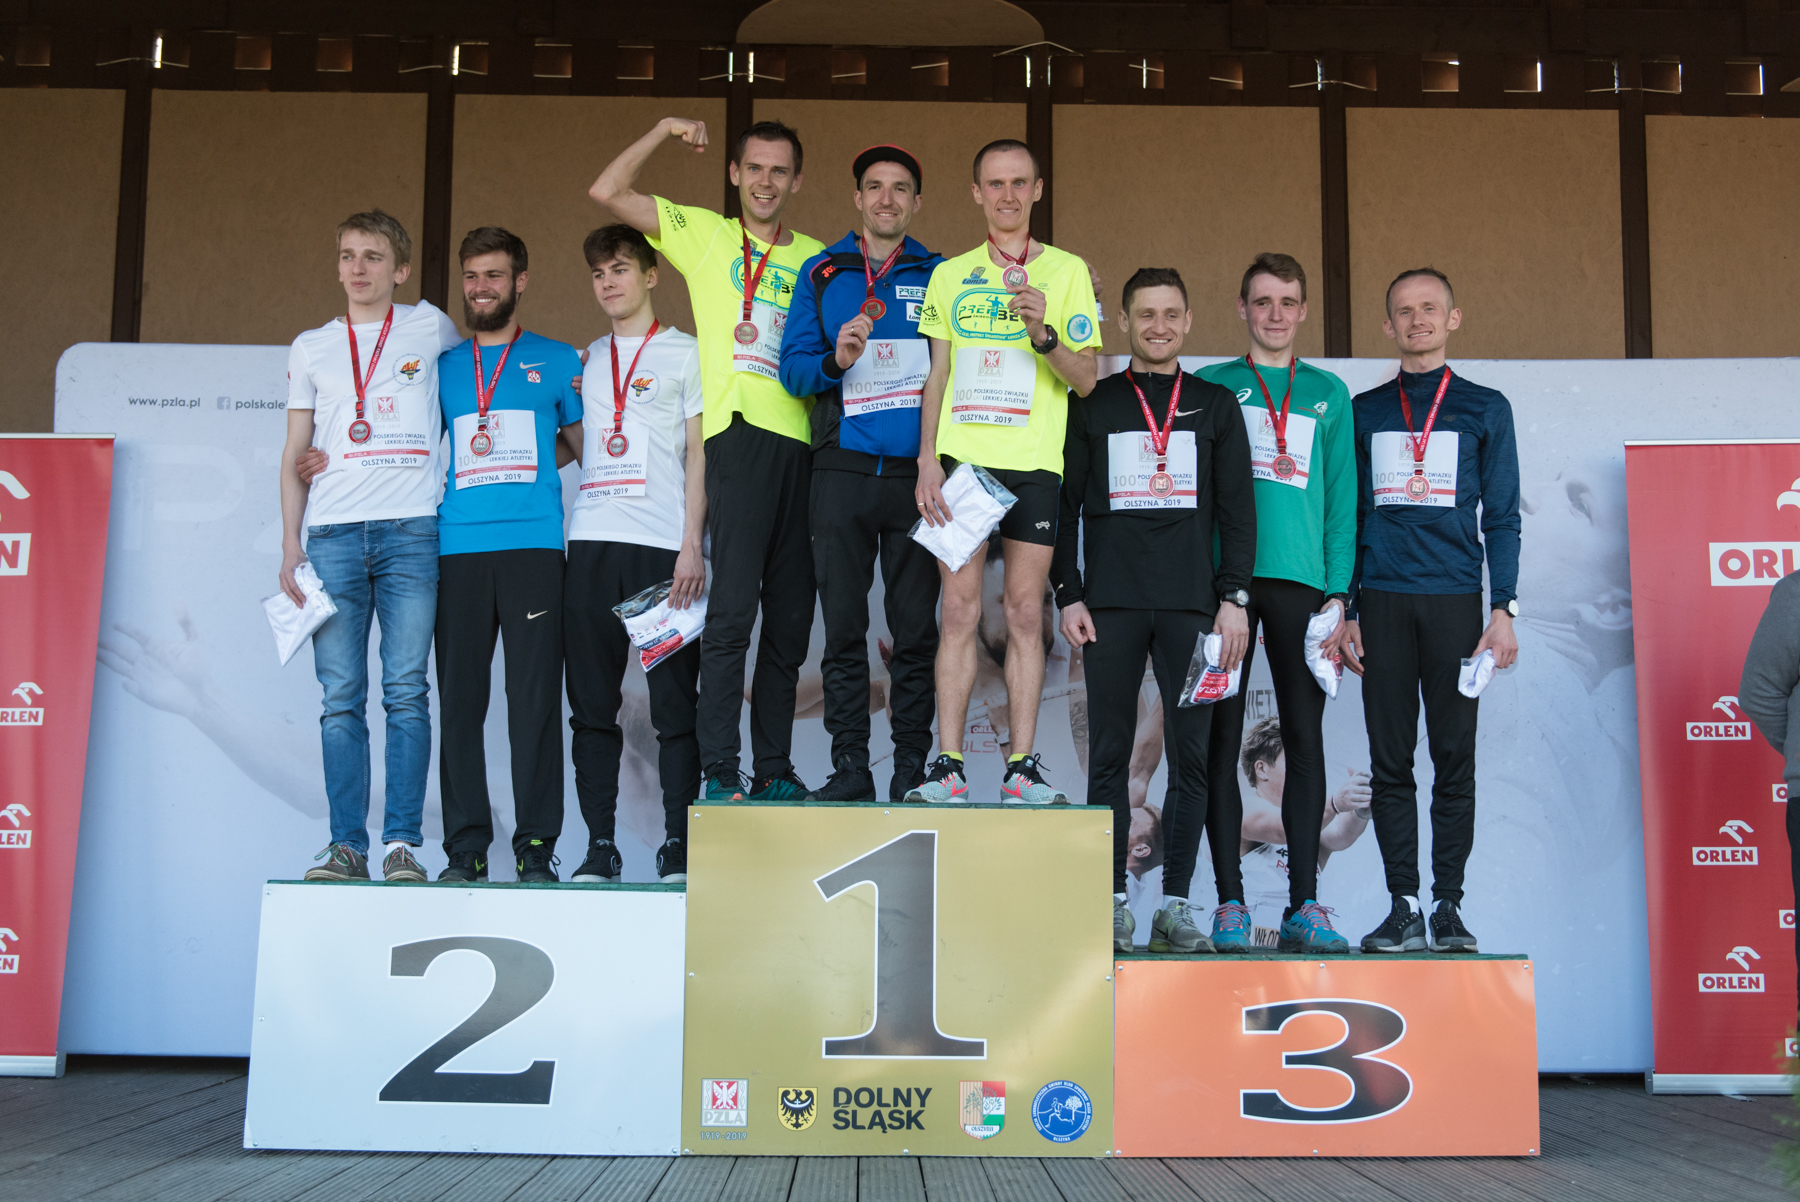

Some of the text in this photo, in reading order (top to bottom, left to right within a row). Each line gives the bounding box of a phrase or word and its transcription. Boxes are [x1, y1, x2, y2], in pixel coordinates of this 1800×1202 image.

[748, 364, 777, 378] OLSZYNA
[848, 382, 872, 394] 100
[956, 389, 973, 402] 100
[128, 397, 200, 409] www.pzla.pl
[862, 401, 896, 412] OLSZYNA
[362, 458, 396, 467] OLSZYNA
[468, 475, 500, 485] OLSZYNA
[1114, 474, 1136, 487] 100
[1376, 472, 1395, 484] 100
[587, 490, 611, 498] OLSZYNA
[0, 711, 40, 723] RLEN
[1690, 725, 1746, 738] ORLEN
[1696, 850, 1754, 862] ORLEN
[813, 830, 988, 1060] 1
[1702, 976, 1760, 989] ORLEN
[379, 935, 556, 1105] 2
[1241, 998, 1412, 1124] 3
[834, 1087, 932, 1108] DOLNY
[704, 1110, 743, 1124] PZLA
[832, 1104, 925, 1133] ŚLĄSK
[700, 1131, 747, 1140] 1919-2019
